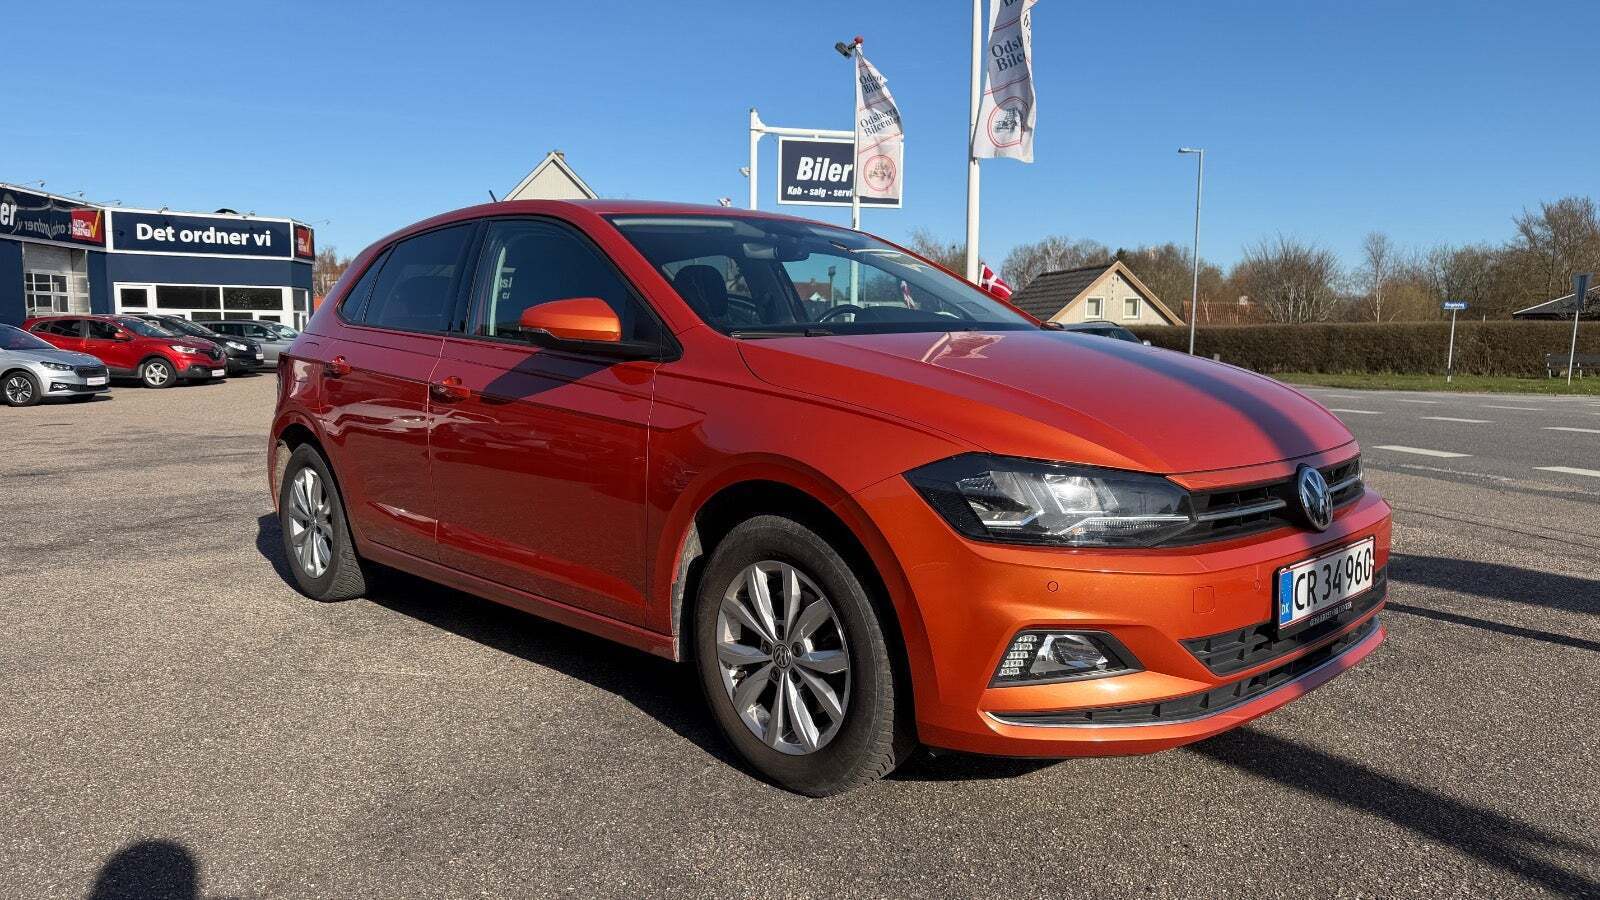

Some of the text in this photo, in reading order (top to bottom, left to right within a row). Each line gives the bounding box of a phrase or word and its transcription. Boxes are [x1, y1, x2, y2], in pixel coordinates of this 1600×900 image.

[796, 156, 854, 182] Biler
[809, 187, 827, 198] salg
[833, 188, 854, 197] servi
[136, 223, 271, 247] Det ordner vi
[1294, 547, 1372, 611] CR 34 960
[1281, 601, 1290, 616] DK
